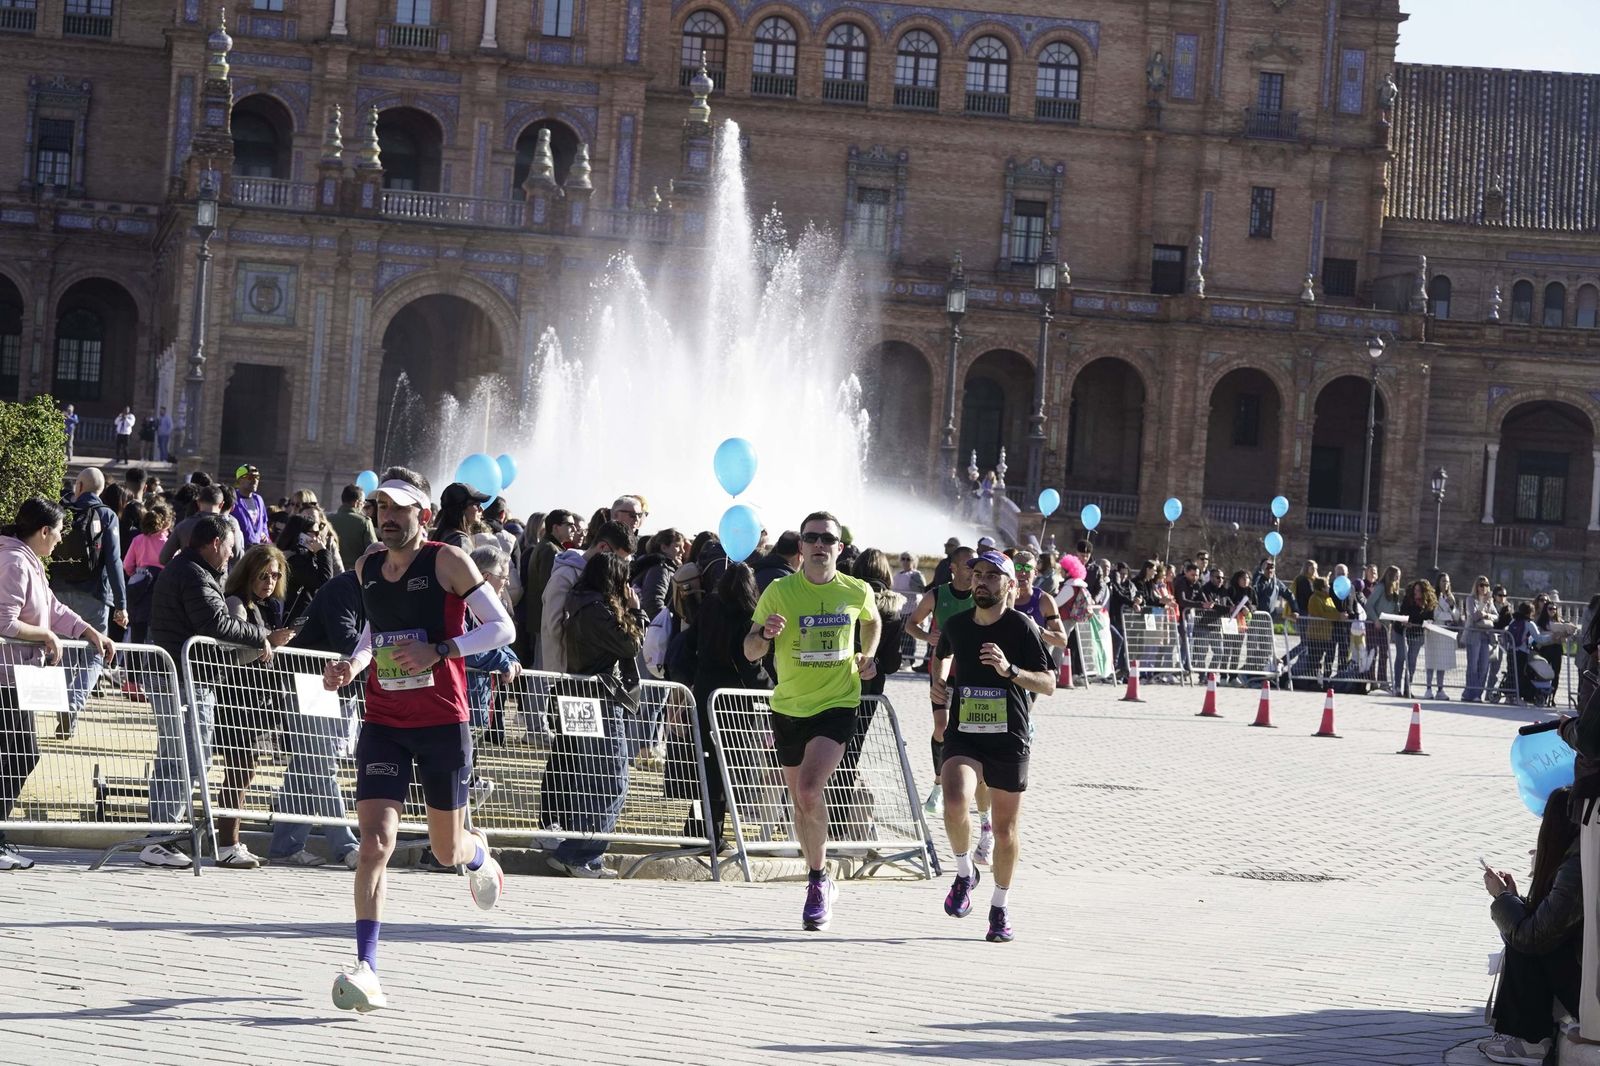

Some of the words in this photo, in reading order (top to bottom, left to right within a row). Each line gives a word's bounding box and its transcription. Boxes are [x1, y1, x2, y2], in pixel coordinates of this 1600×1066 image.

[818, 616, 846, 624] ZURICH
[821, 640, 833, 650] TJ
[973, 689, 1001, 697] ZURICH
[974, 703, 989, 711] 1738
[966, 712, 997, 722] JIBICH
